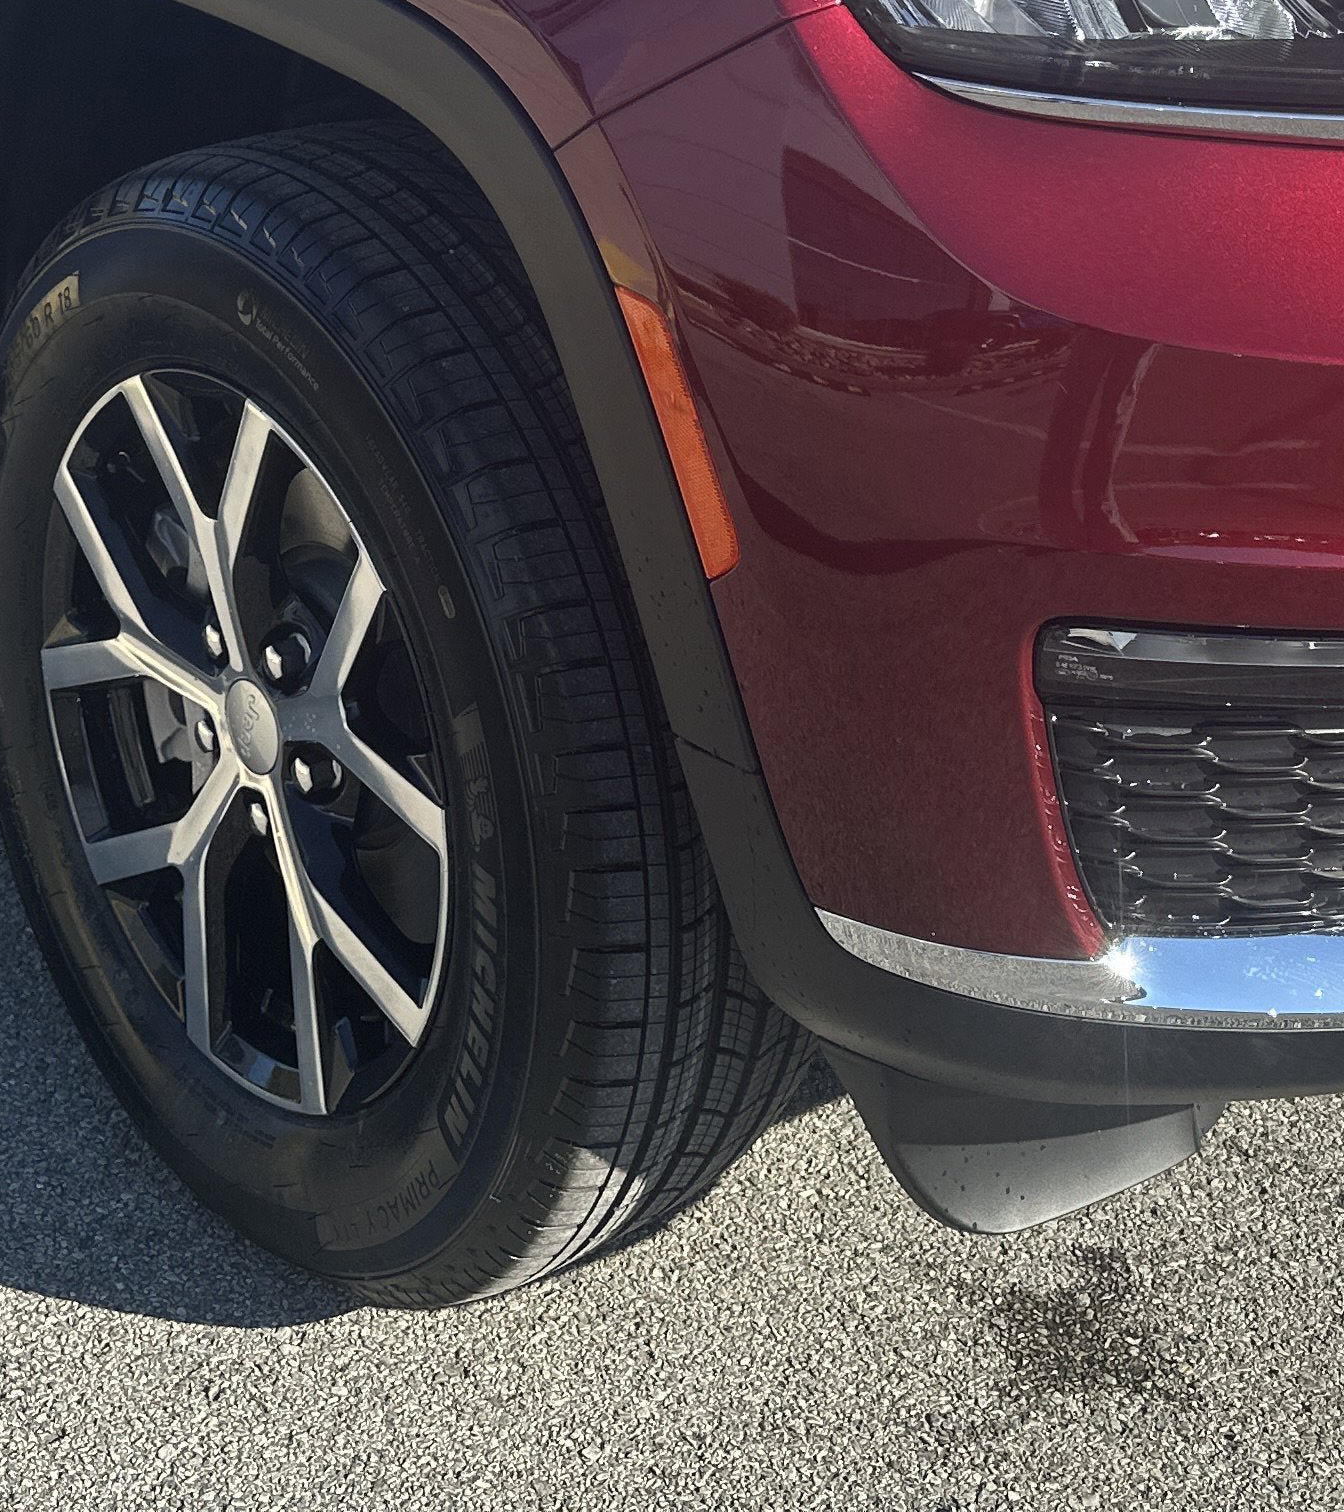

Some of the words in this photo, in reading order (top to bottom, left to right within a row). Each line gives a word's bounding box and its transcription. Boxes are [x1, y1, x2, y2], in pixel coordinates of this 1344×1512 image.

[58, 286, 72, 315] 18
[271, 333, 320, 392] Performance
[443, 862, 498, 1148] MICHELIN
[365, 1158, 441, 1236] PRIMACY
